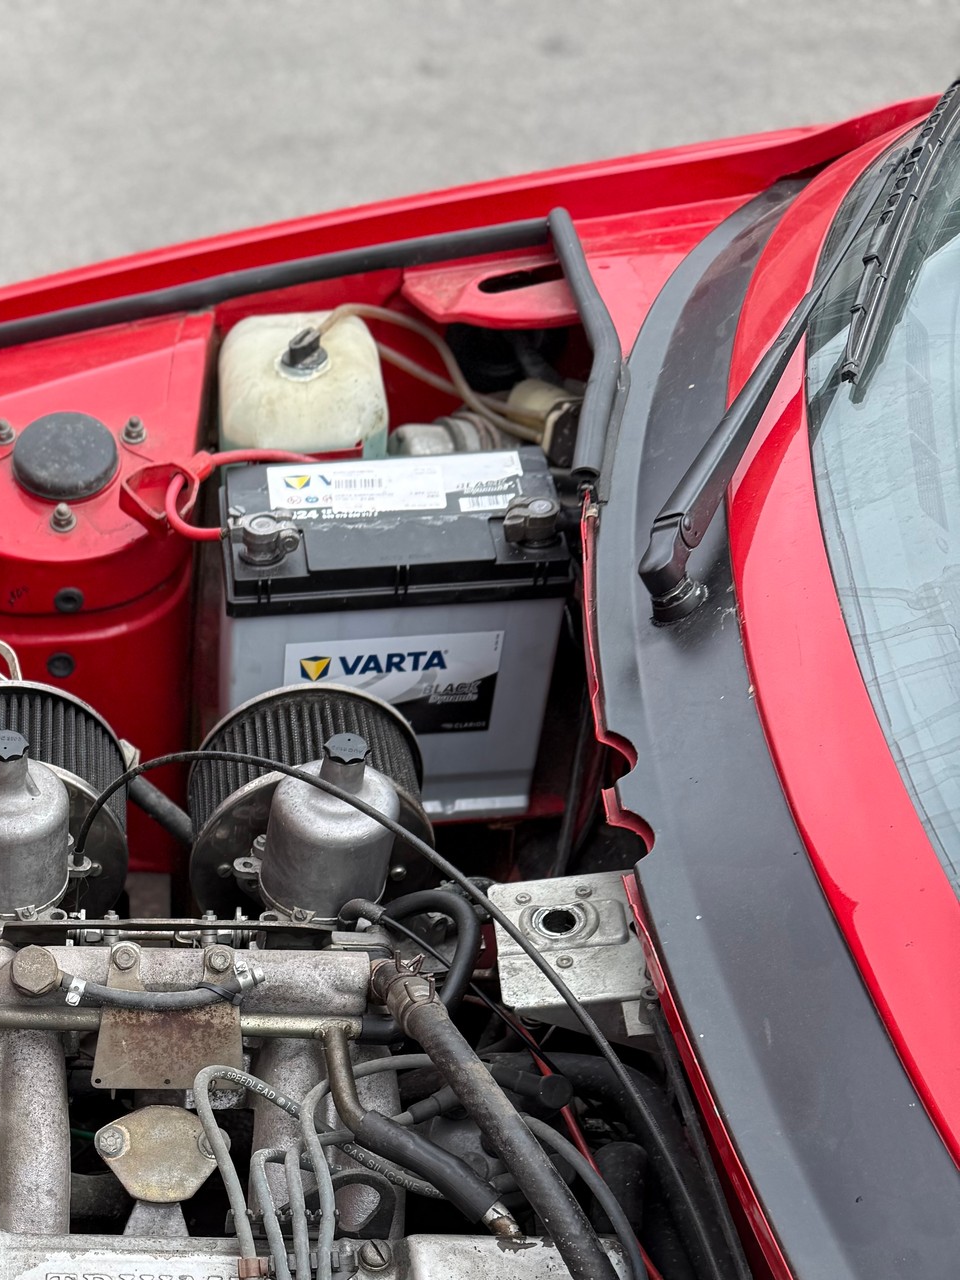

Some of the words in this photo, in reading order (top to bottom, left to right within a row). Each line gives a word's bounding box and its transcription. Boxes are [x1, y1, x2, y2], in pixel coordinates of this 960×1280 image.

[339, 650, 447, 676] VARTA
[422, 681, 482, 695] BLACK
[226, 1072, 276, 1100] SPEEDLEAD
